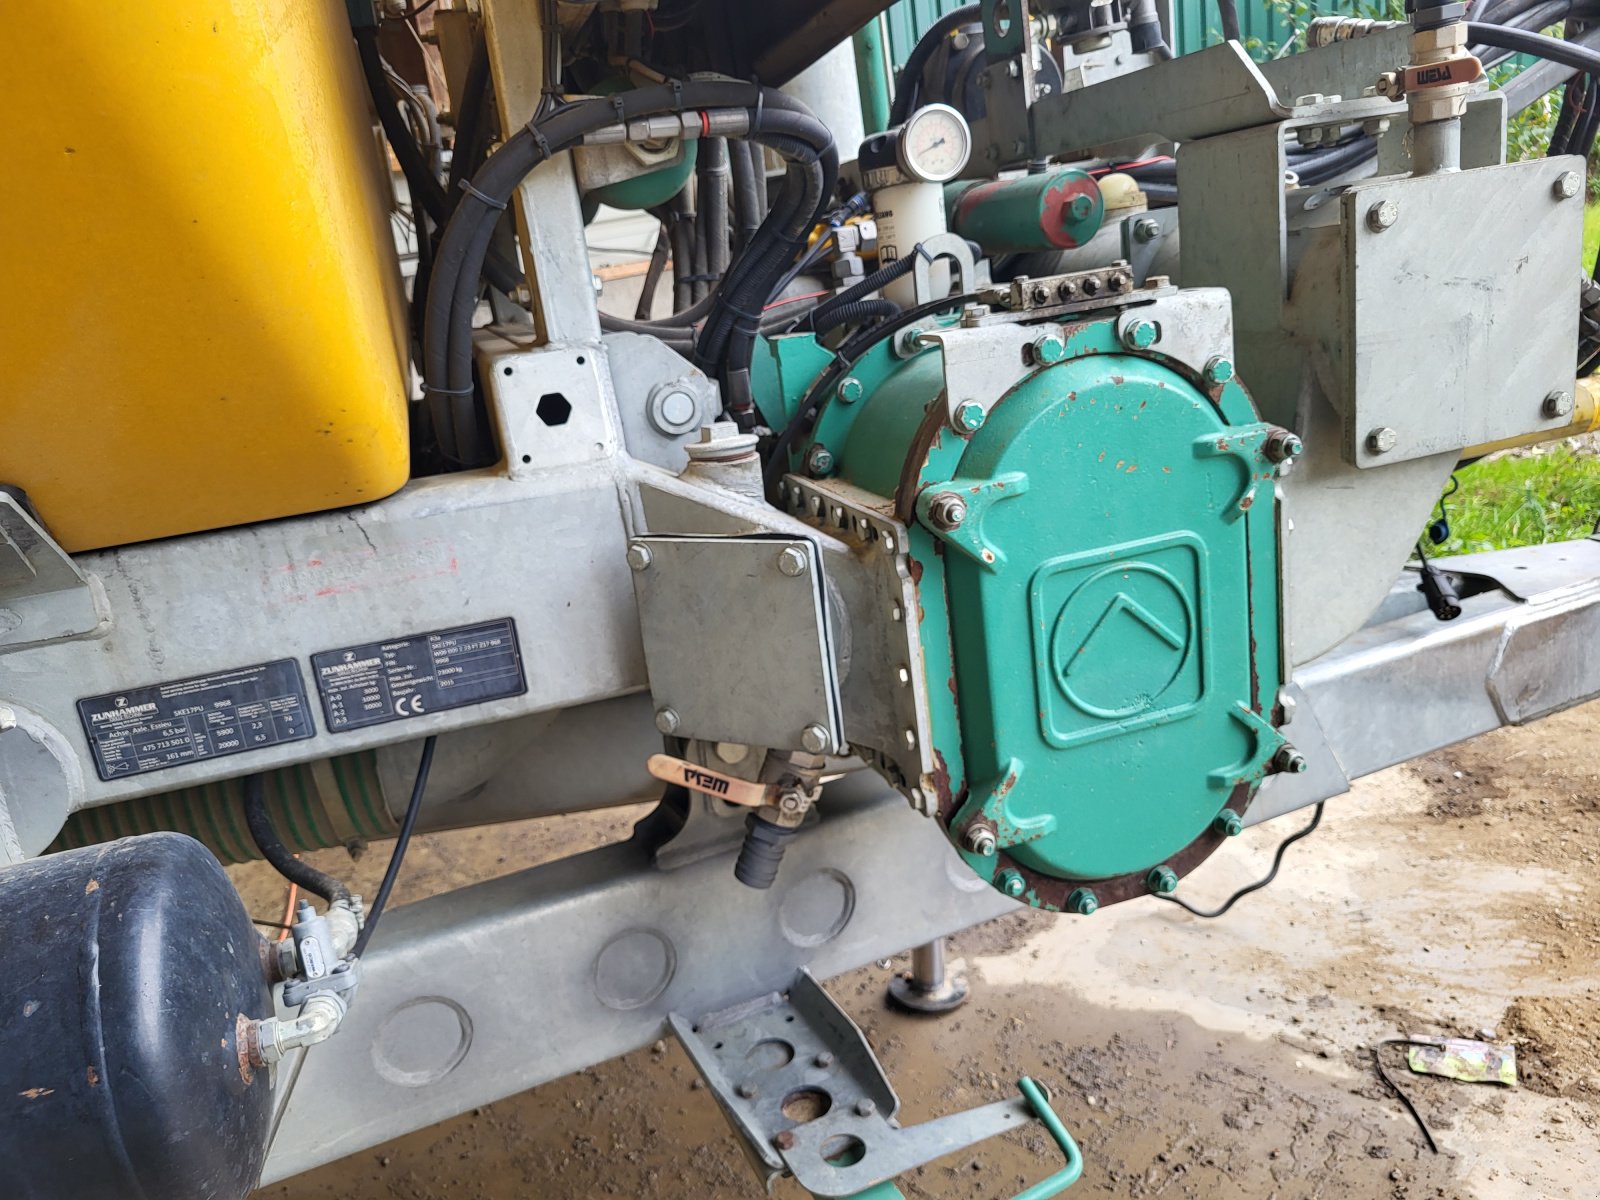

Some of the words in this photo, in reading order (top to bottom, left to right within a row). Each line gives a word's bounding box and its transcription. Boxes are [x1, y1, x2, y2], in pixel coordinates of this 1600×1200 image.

[320, 657, 381, 675] ZUNHAMMER
[91, 702, 156, 721] ZUNHAMMER
[173, 705, 204, 717] SKE17PU
[213, 699, 232, 709] 9968
[395, 694, 425, 716] CE
[150, 721, 172, 730] Essieu
[162, 728, 175, 738] 6,5
[175, 726, 187, 735] bar
[142, 742, 157, 752] 475
[157, 739, 171, 750] 713
[171, 737, 184, 747] 501
[217, 739, 240, 749] 20000
[166, 751, 179, 761] 161
[180, 749, 194, 758] mm
